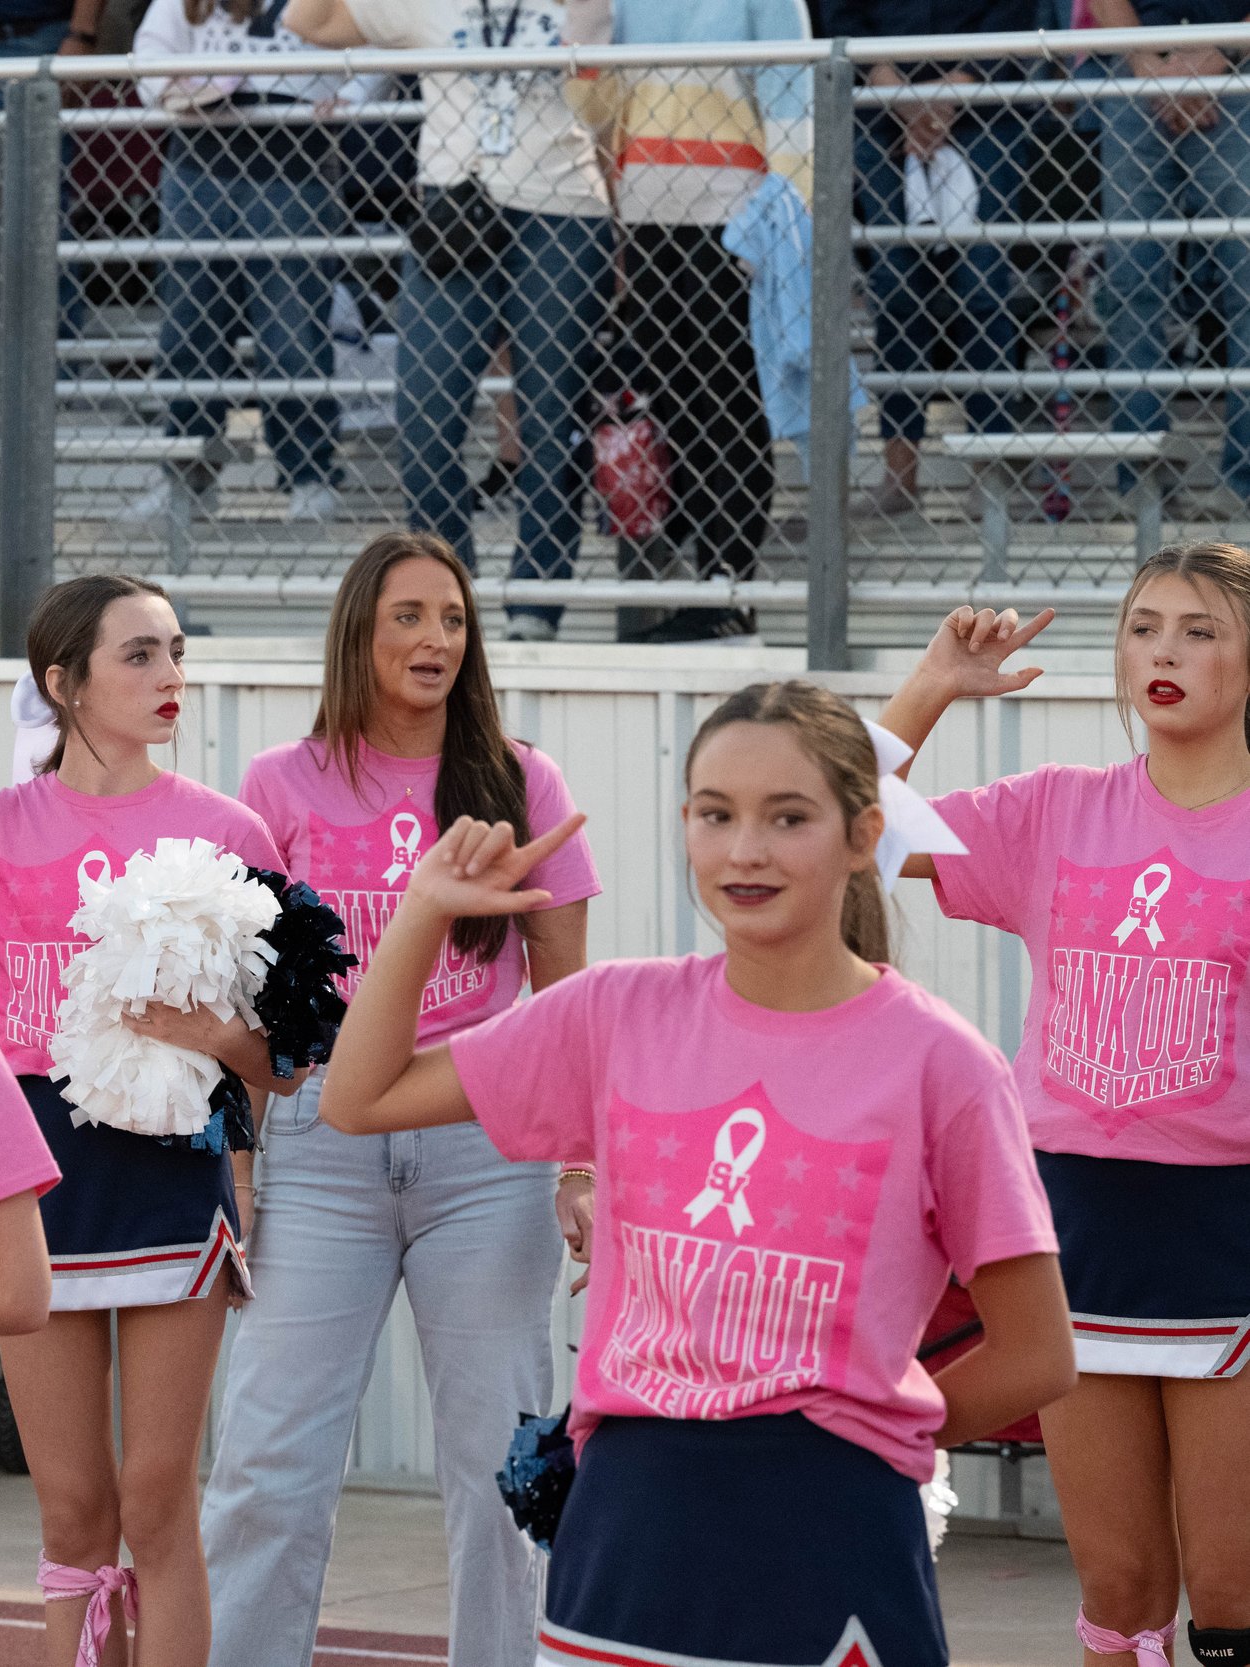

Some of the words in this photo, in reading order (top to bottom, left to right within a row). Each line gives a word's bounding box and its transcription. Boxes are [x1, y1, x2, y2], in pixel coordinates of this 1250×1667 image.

[1127, 896, 1160, 929] SV
[6, 941, 97, 1035] PIN
[420, 967, 487, 1016] ALLEY
[1049, 948, 1143, 1074] PINK
[1136, 958, 1232, 1070] OUT
[1066, 1052, 1110, 1104] THE
[1113, 1055, 1220, 1109] VALLEY
[706, 1160, 750, 1207] SV
[709, 1245, 845, 1386] OUT
